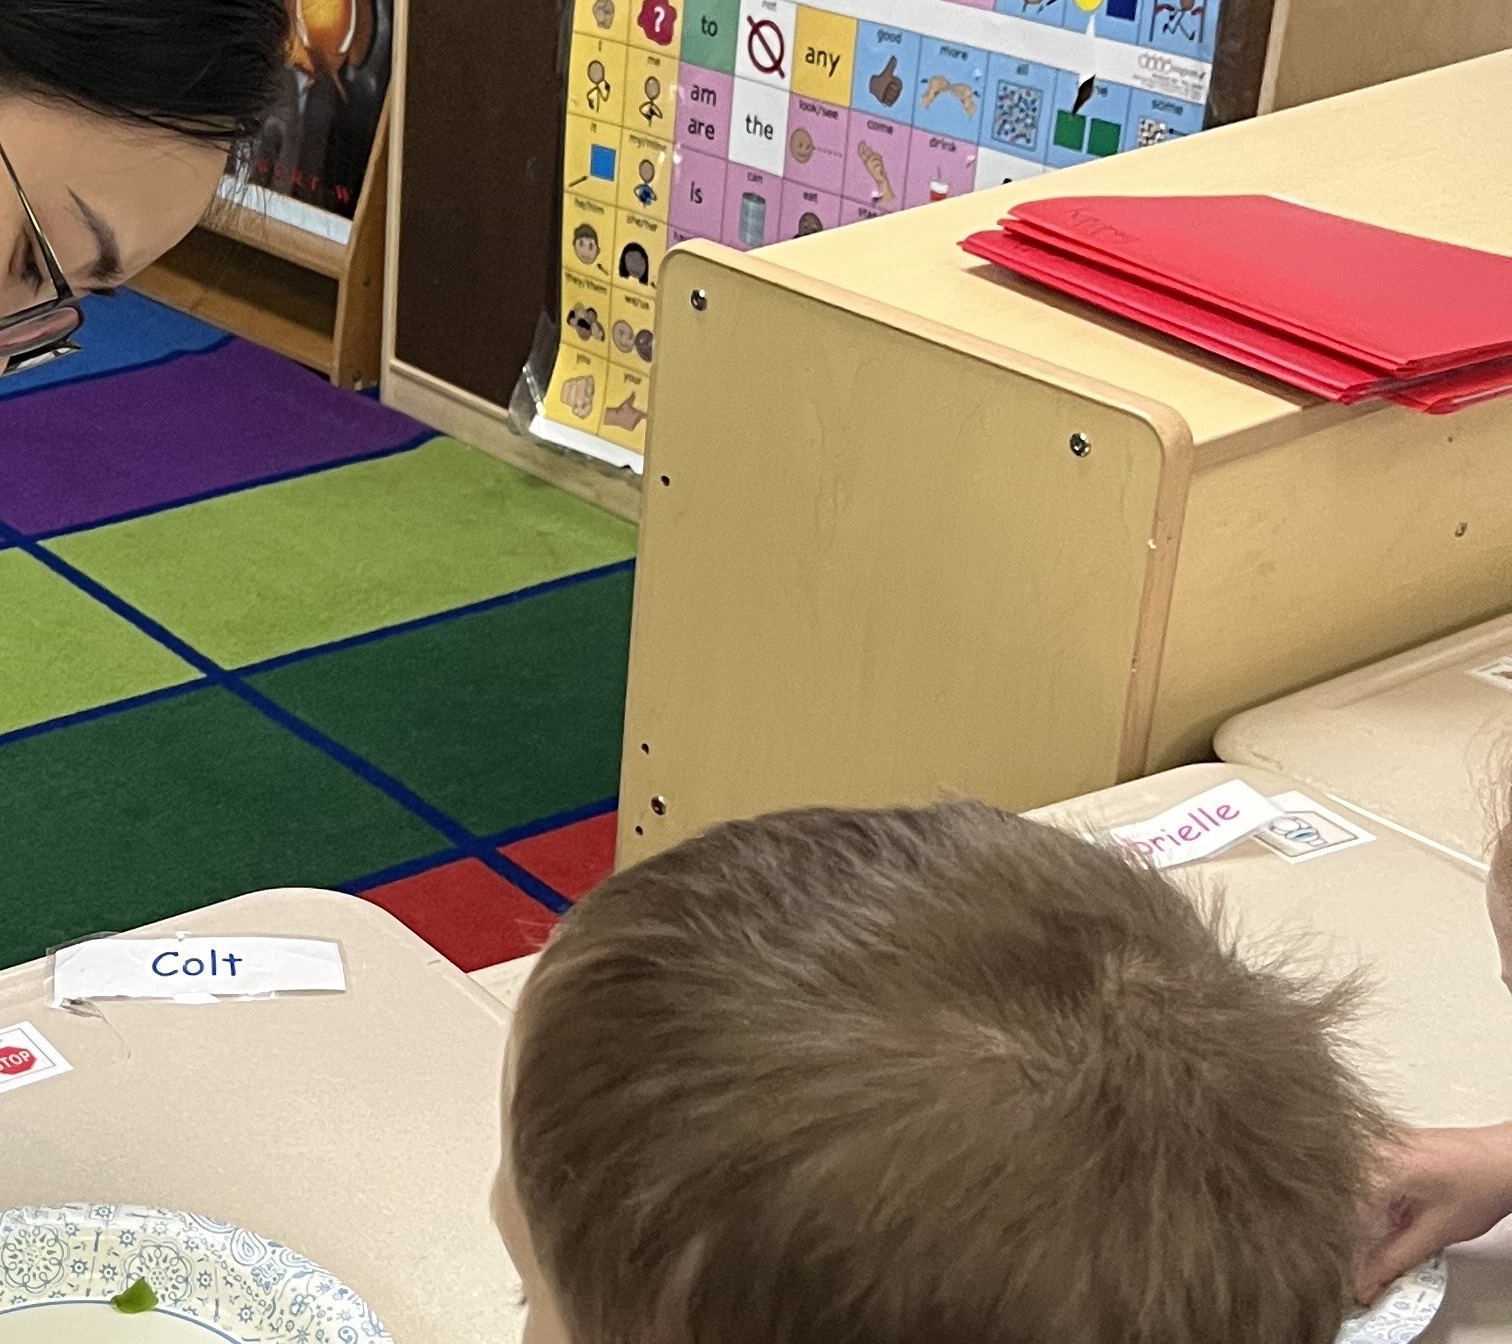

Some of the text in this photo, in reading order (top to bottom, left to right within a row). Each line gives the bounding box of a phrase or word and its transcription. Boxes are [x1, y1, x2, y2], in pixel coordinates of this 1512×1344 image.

[701, 15, 718, 37] to
[805, 46, 840, 78] any
[690, 84, 717, 106] am
[687, 119, 715, 140] are
[746, 115, 774, 140] the
[690, 181, 703, 204] is
[152, 950, 242, 977] Colt
